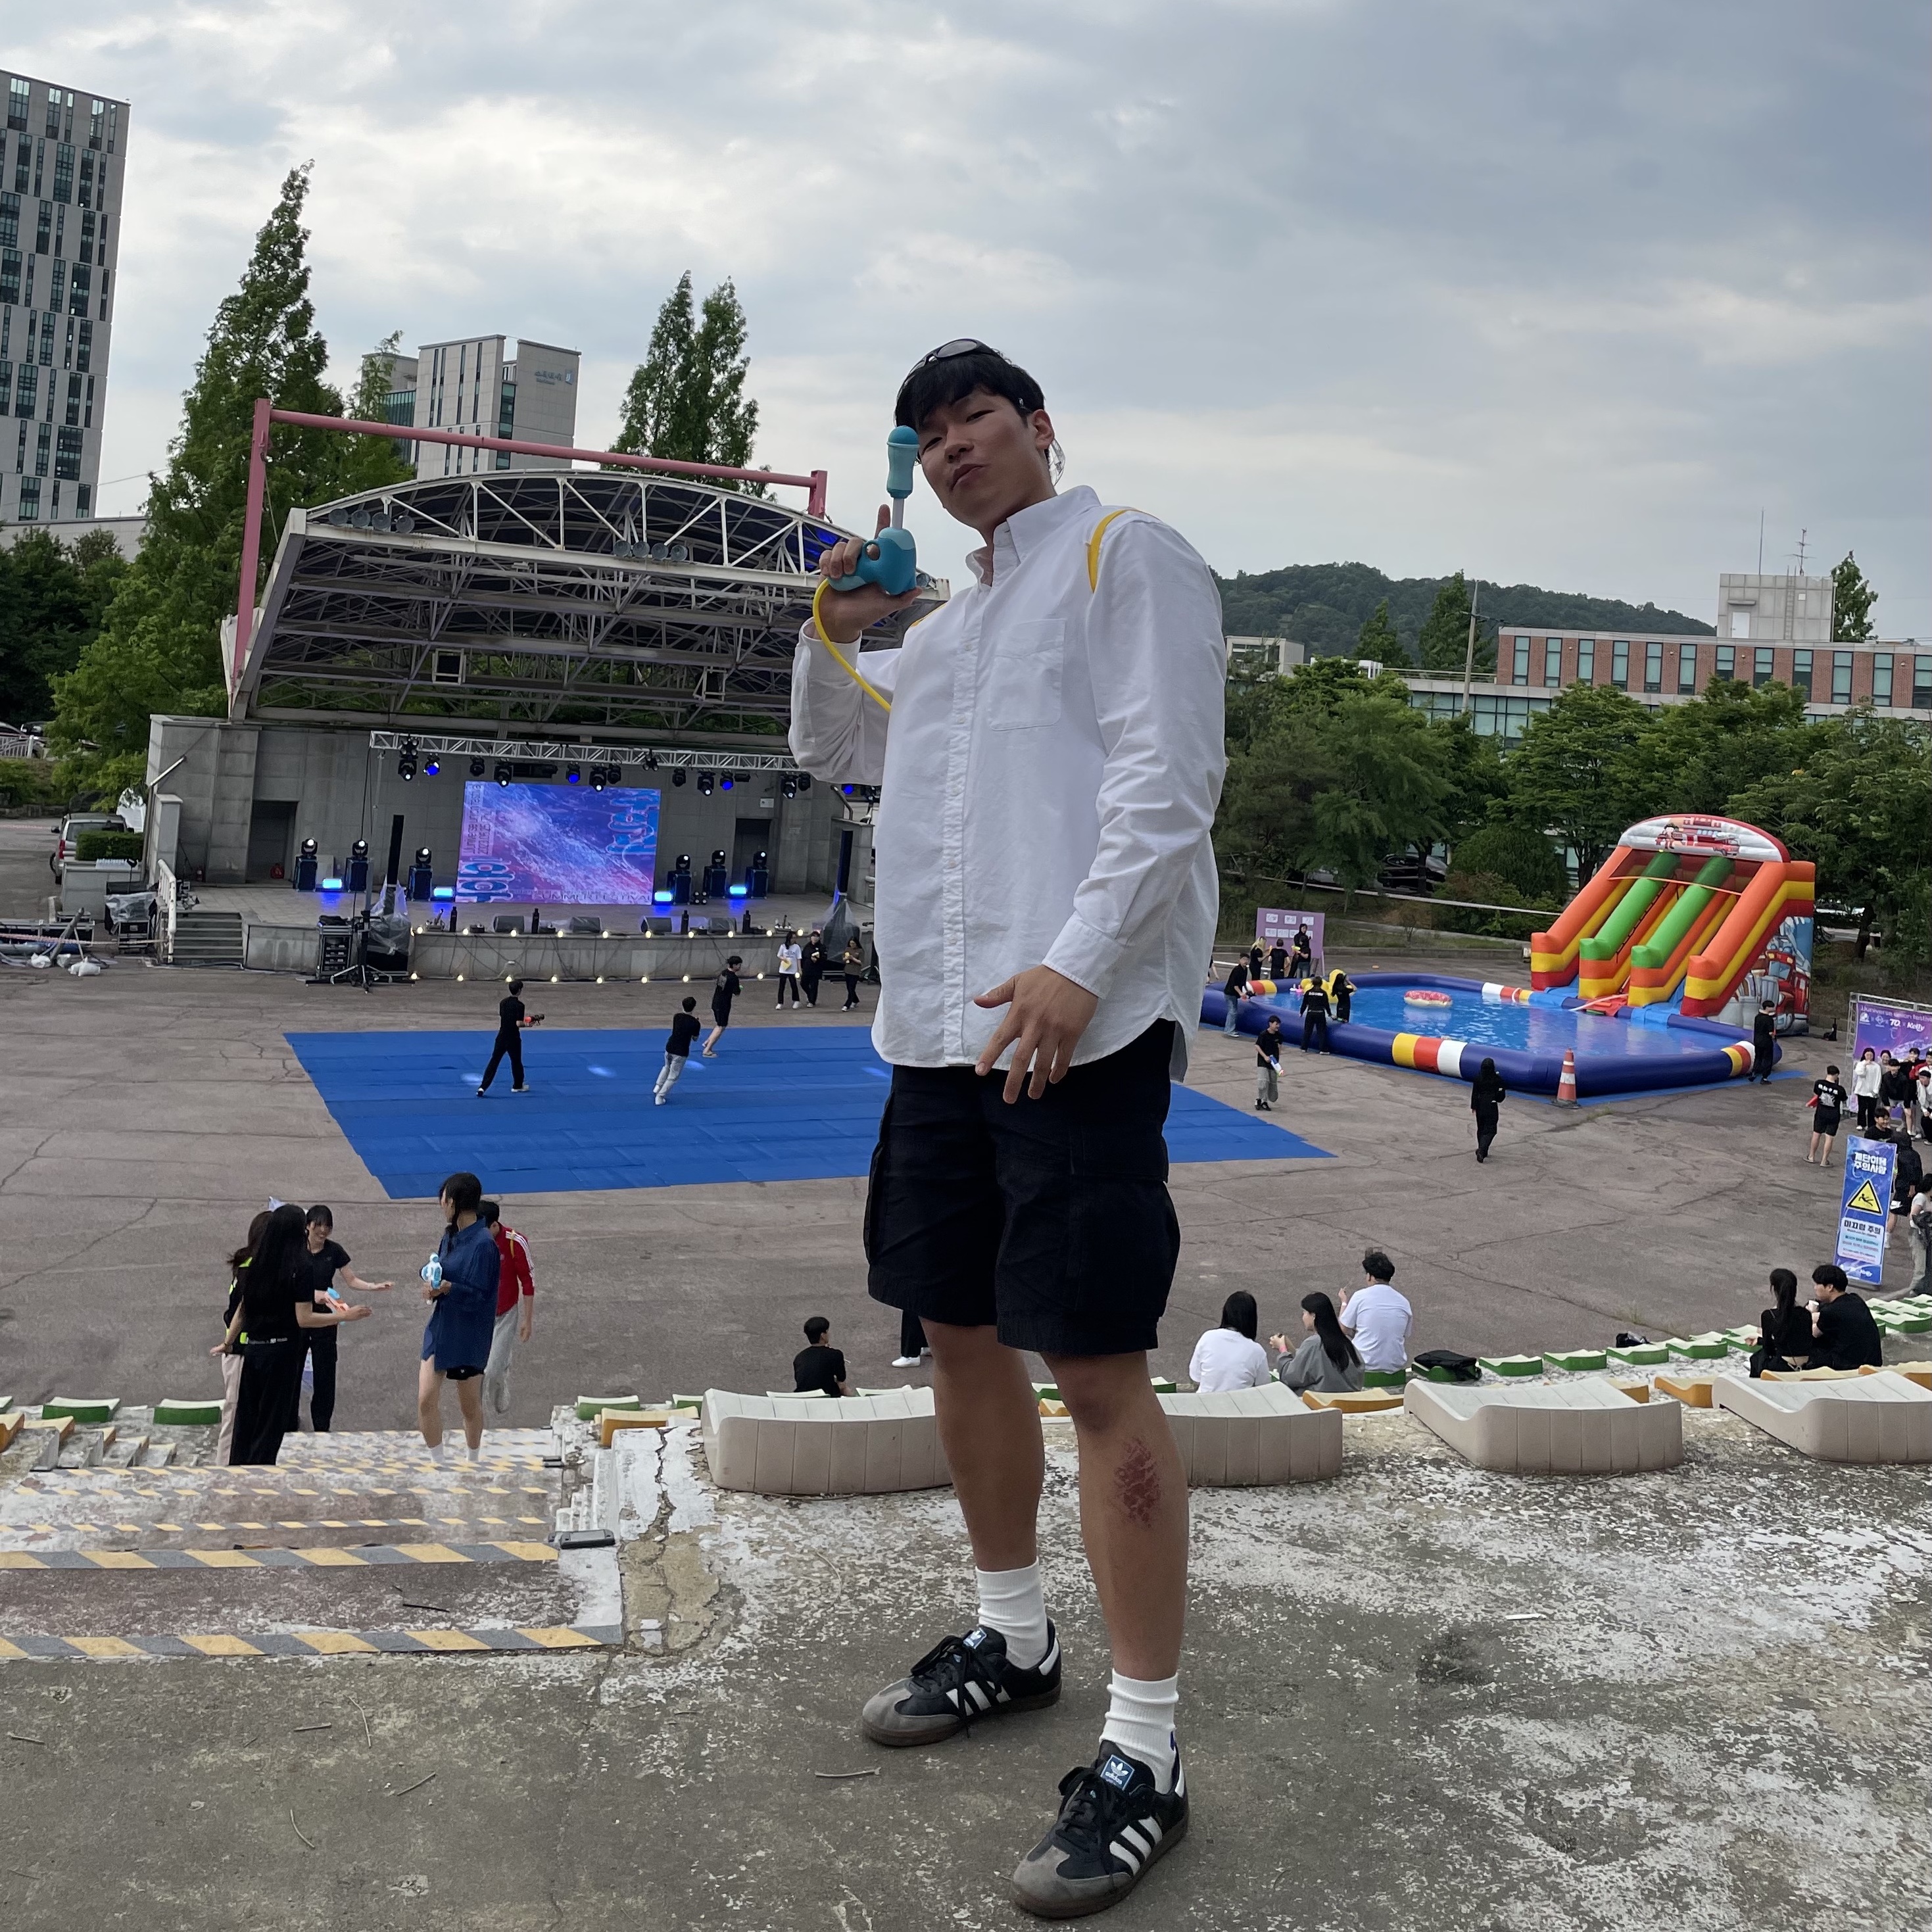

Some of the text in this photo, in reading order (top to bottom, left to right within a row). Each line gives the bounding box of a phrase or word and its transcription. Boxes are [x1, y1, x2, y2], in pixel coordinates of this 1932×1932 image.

[1854, 1161, 1887, 1174] 주의사항
[1844, 1220, 1866, 1230] 미끄럼
[1868, 1225, 1881, 1234] 주의
